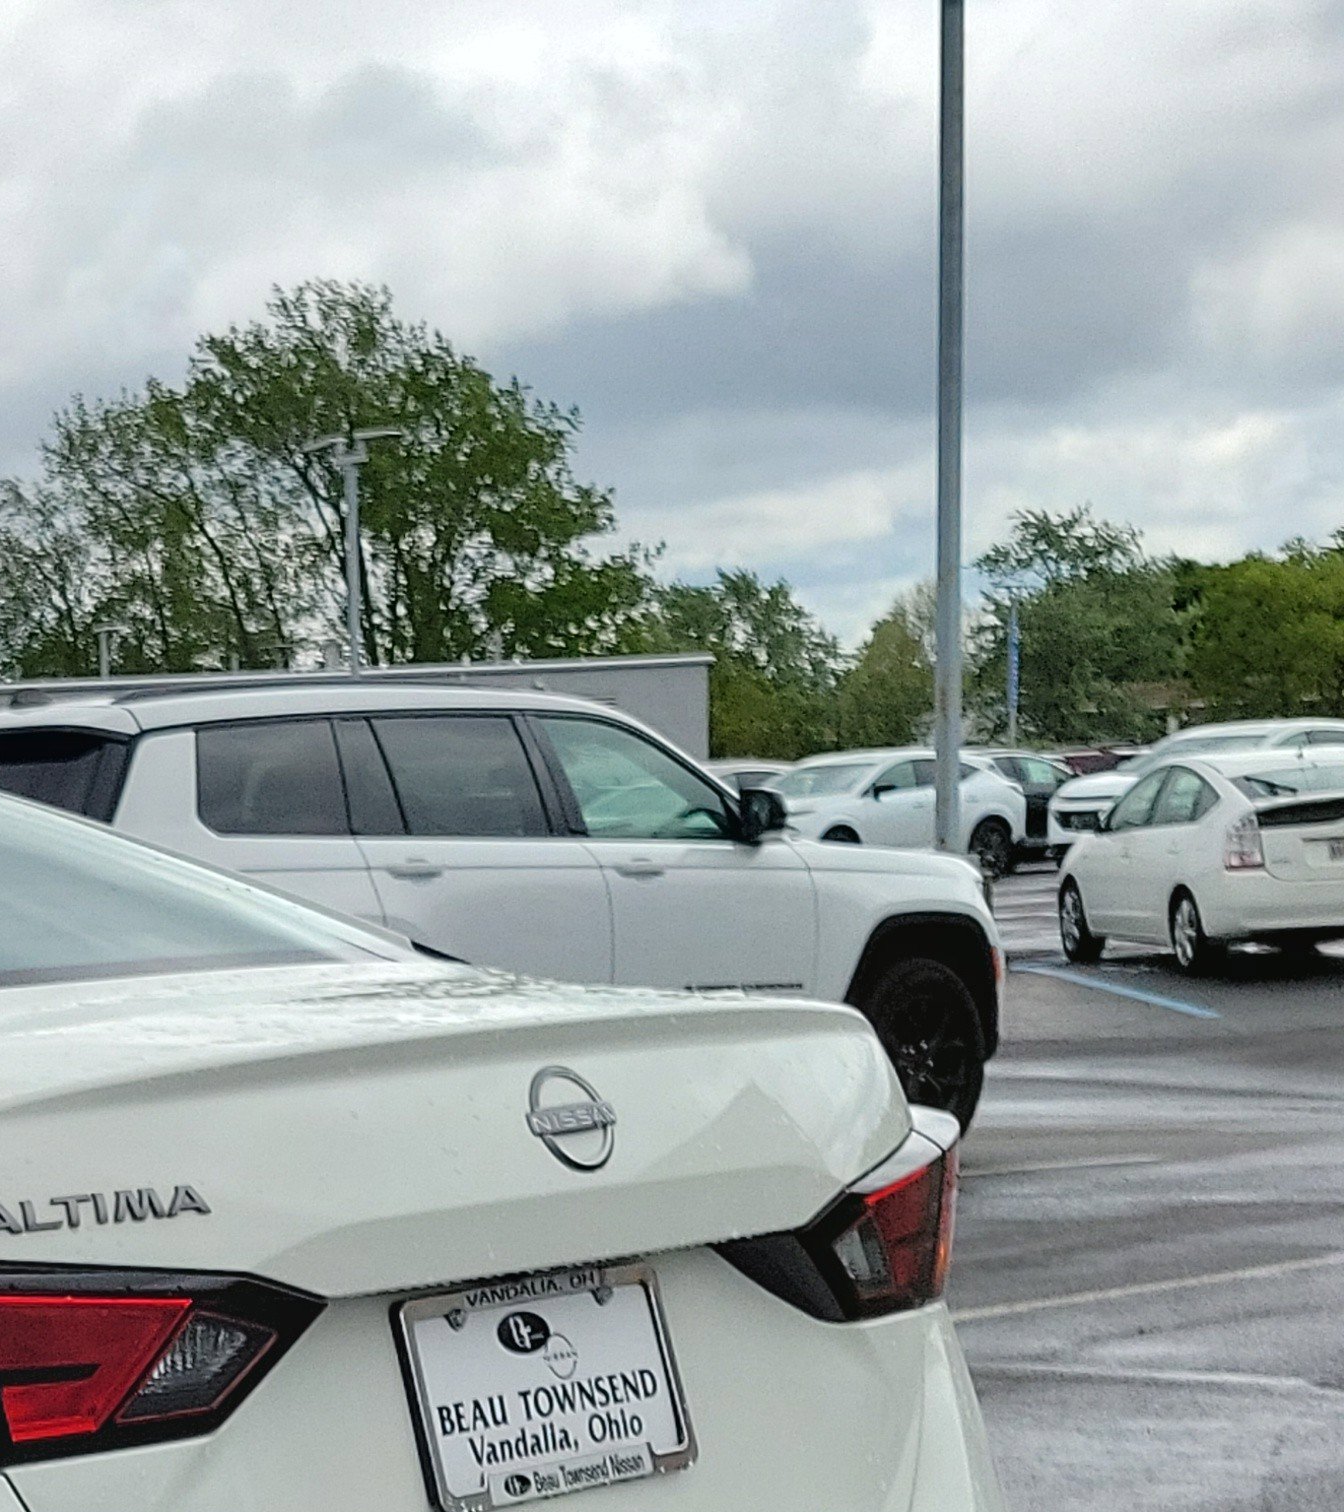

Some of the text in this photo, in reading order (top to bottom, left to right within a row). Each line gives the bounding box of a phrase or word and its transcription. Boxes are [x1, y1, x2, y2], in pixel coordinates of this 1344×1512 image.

[529, 1106, 616, 1134] NISSAN
[437, 1368, 658, 1437] BEAU TOWNSEND
[468, 1408, 643, 1467] Vandalia, Ohio
[533, 1453, 645, 1493] Beau Townsend Nissan
